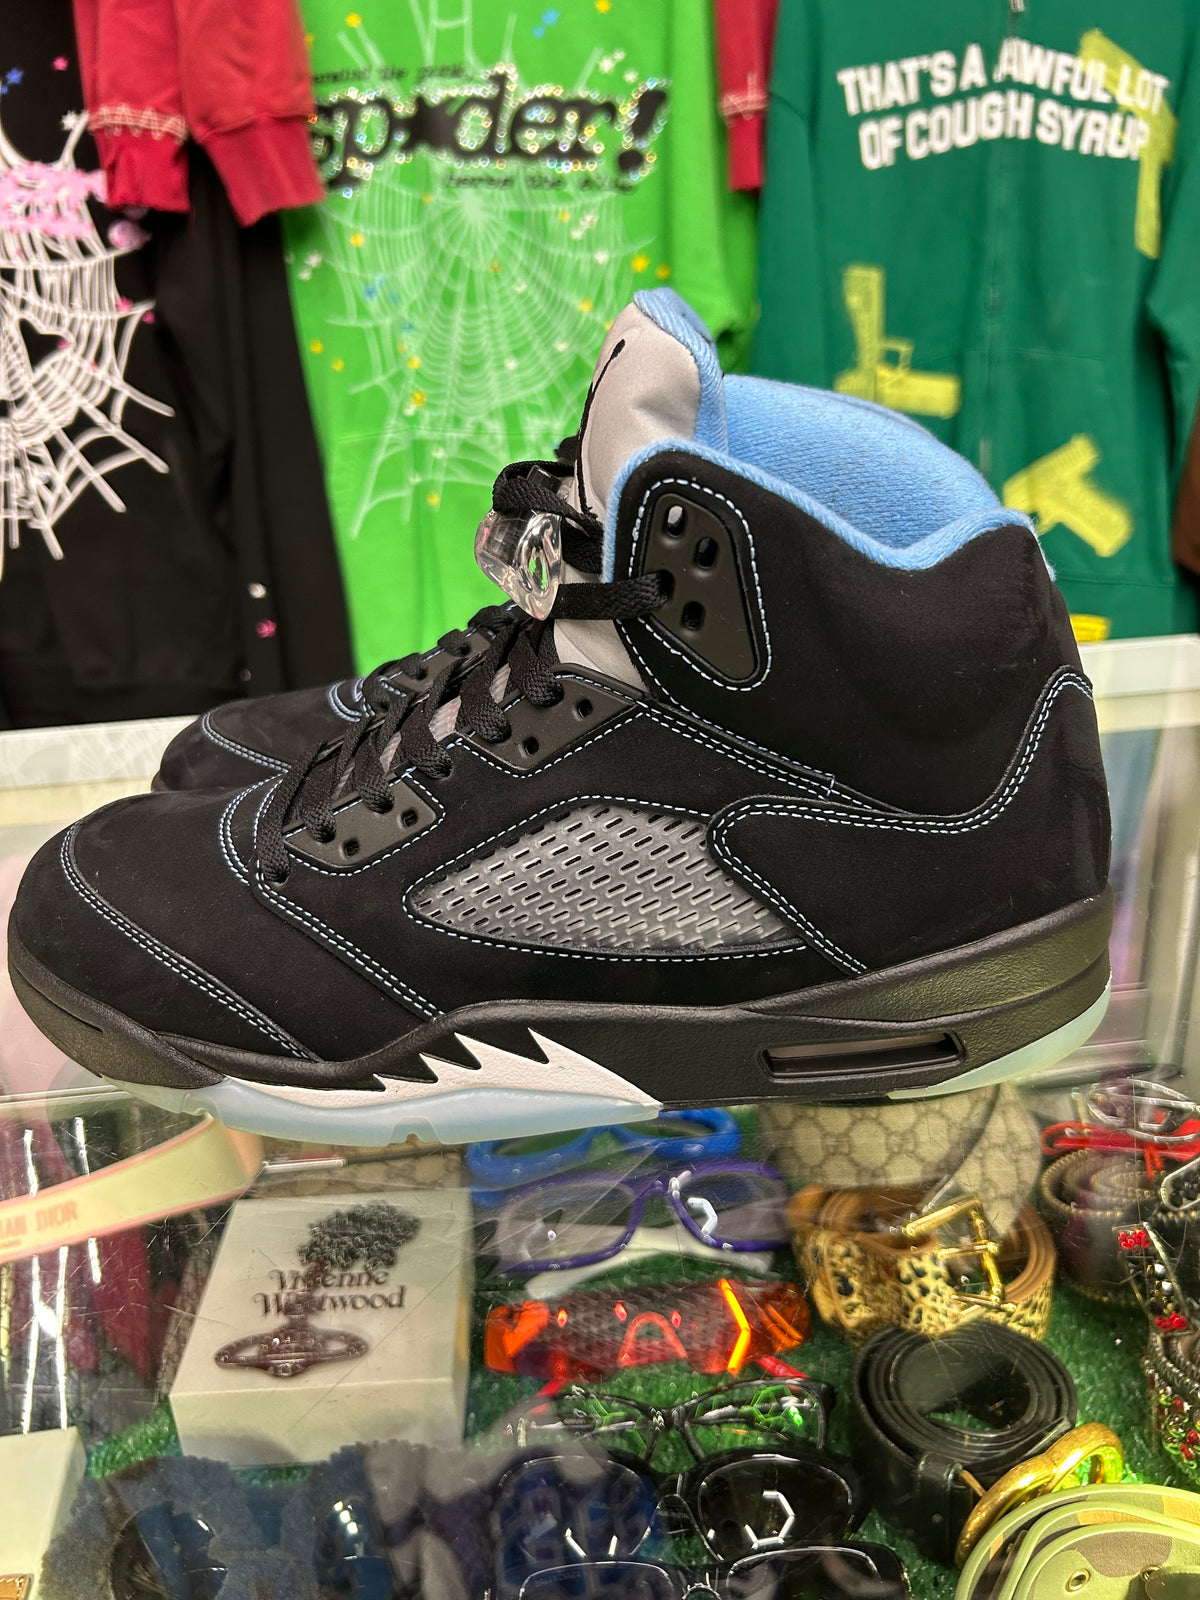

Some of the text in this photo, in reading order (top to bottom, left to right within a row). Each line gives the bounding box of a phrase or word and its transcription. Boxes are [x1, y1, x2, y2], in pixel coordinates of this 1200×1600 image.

[836, 36, 1170, 117] THAT'S A AWFUL LOT
[858, 88, 1150, 171] OF COUGH SYRUP
[35, 1201, 78, 1231] DIOR
